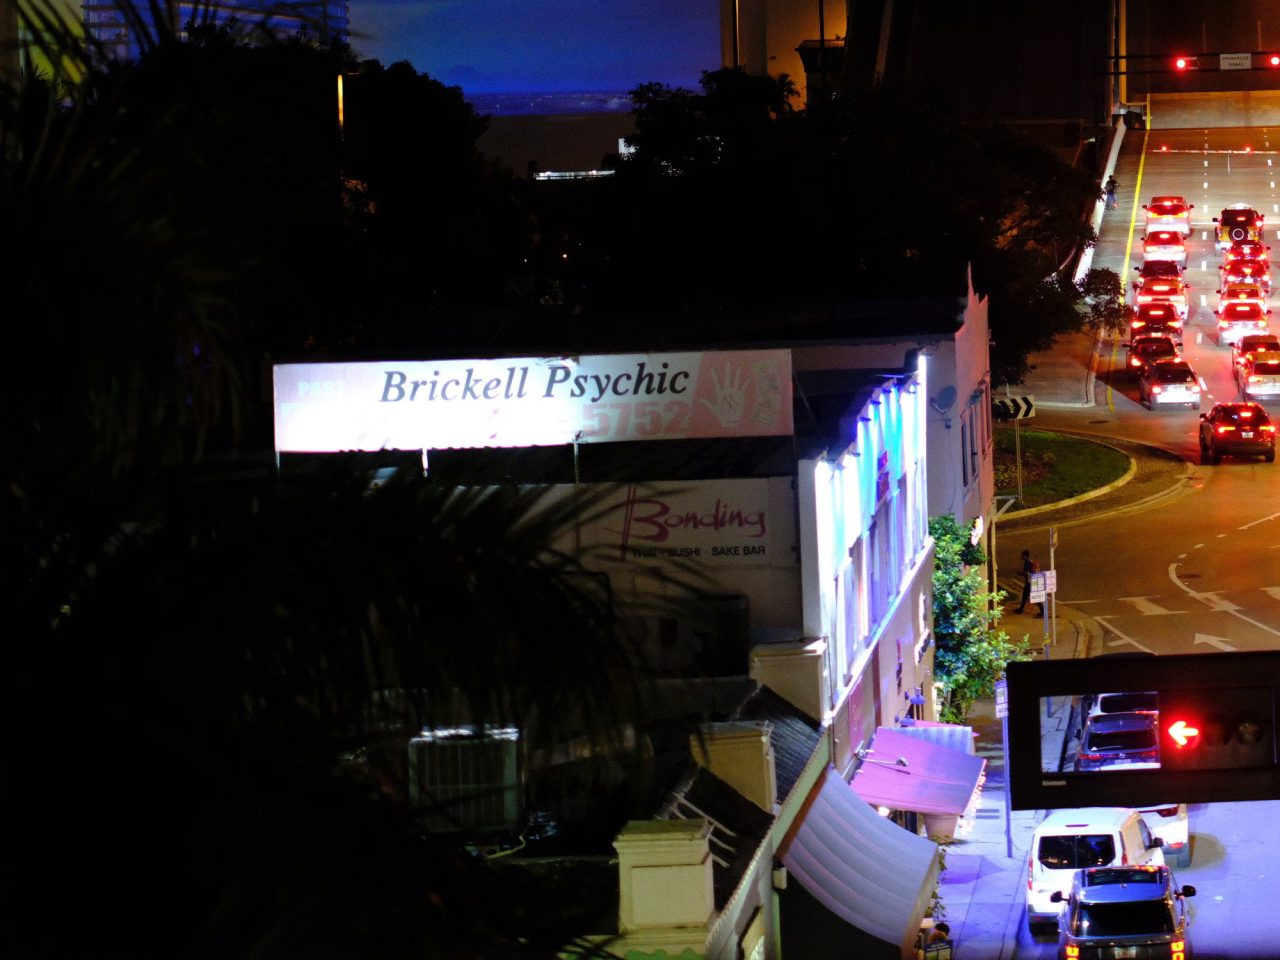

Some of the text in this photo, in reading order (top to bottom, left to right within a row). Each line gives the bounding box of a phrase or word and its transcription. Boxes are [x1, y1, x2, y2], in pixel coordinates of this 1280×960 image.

[380, 362, 690, 403] Brickell Psychic
[582, 400, 690, 437] 5752
[608, 485, 766, 550] Bonding
[668, 546, 700, 558] SUSHI
[711, 546, 739, 557] SAKE
[743, 545, 766, 555] BAR
